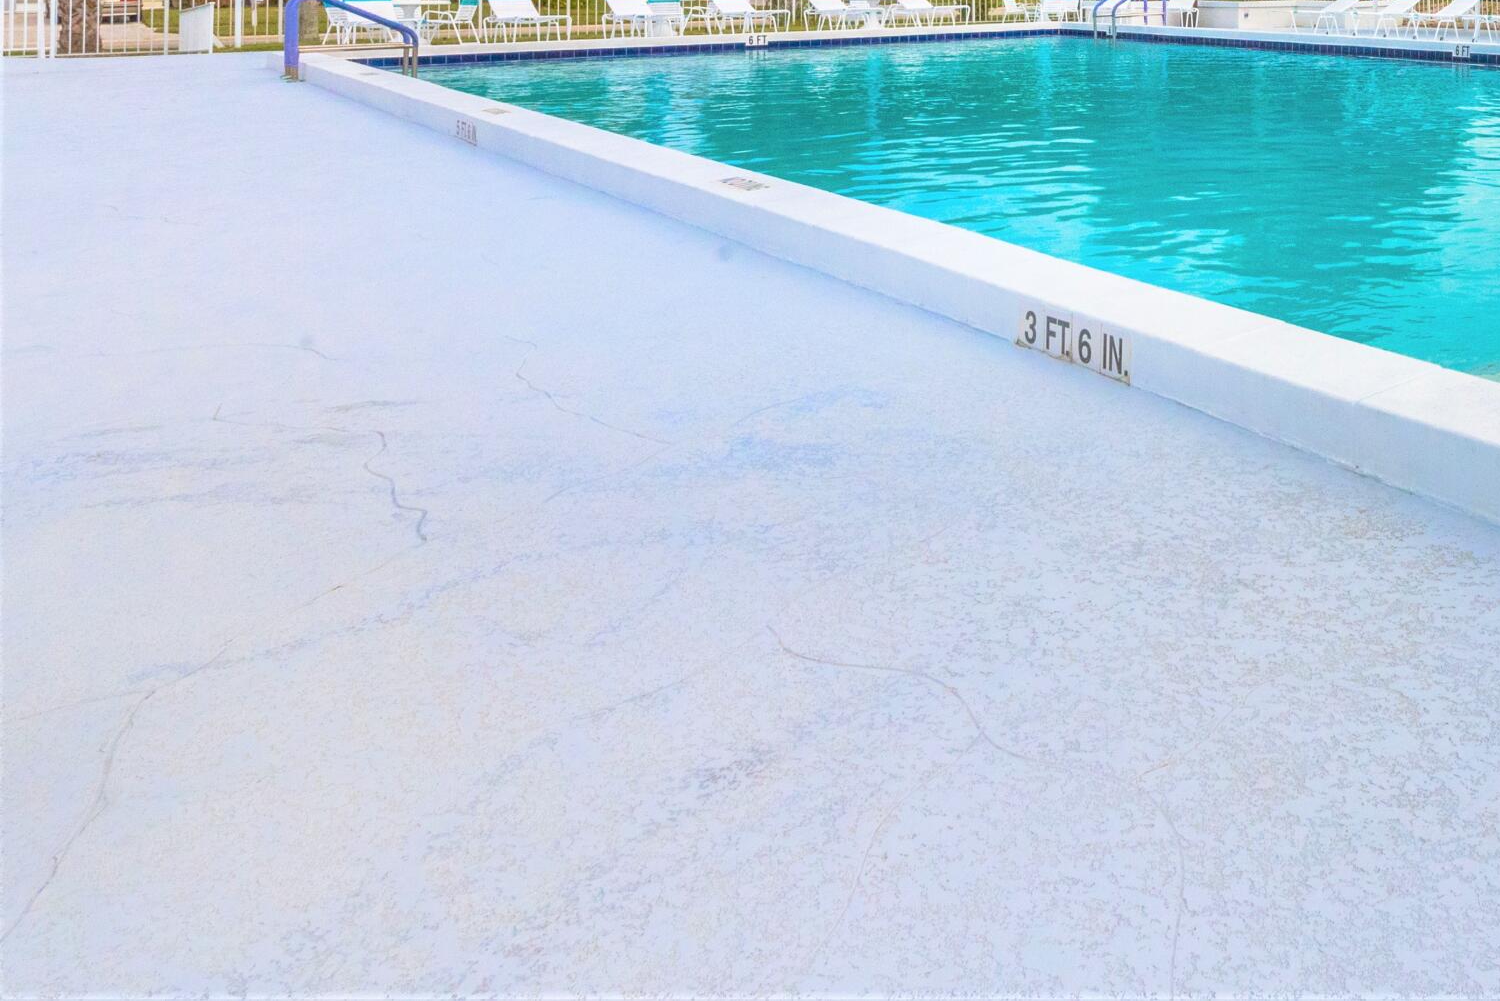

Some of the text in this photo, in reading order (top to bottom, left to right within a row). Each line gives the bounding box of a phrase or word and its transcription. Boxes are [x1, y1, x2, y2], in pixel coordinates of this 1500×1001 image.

[748, 35, 767, 45] 6 FT
[1455, 45, 1470, 57] 6 FT
[1025, 311, 1129, 377] 3 FT. 6 IN.
